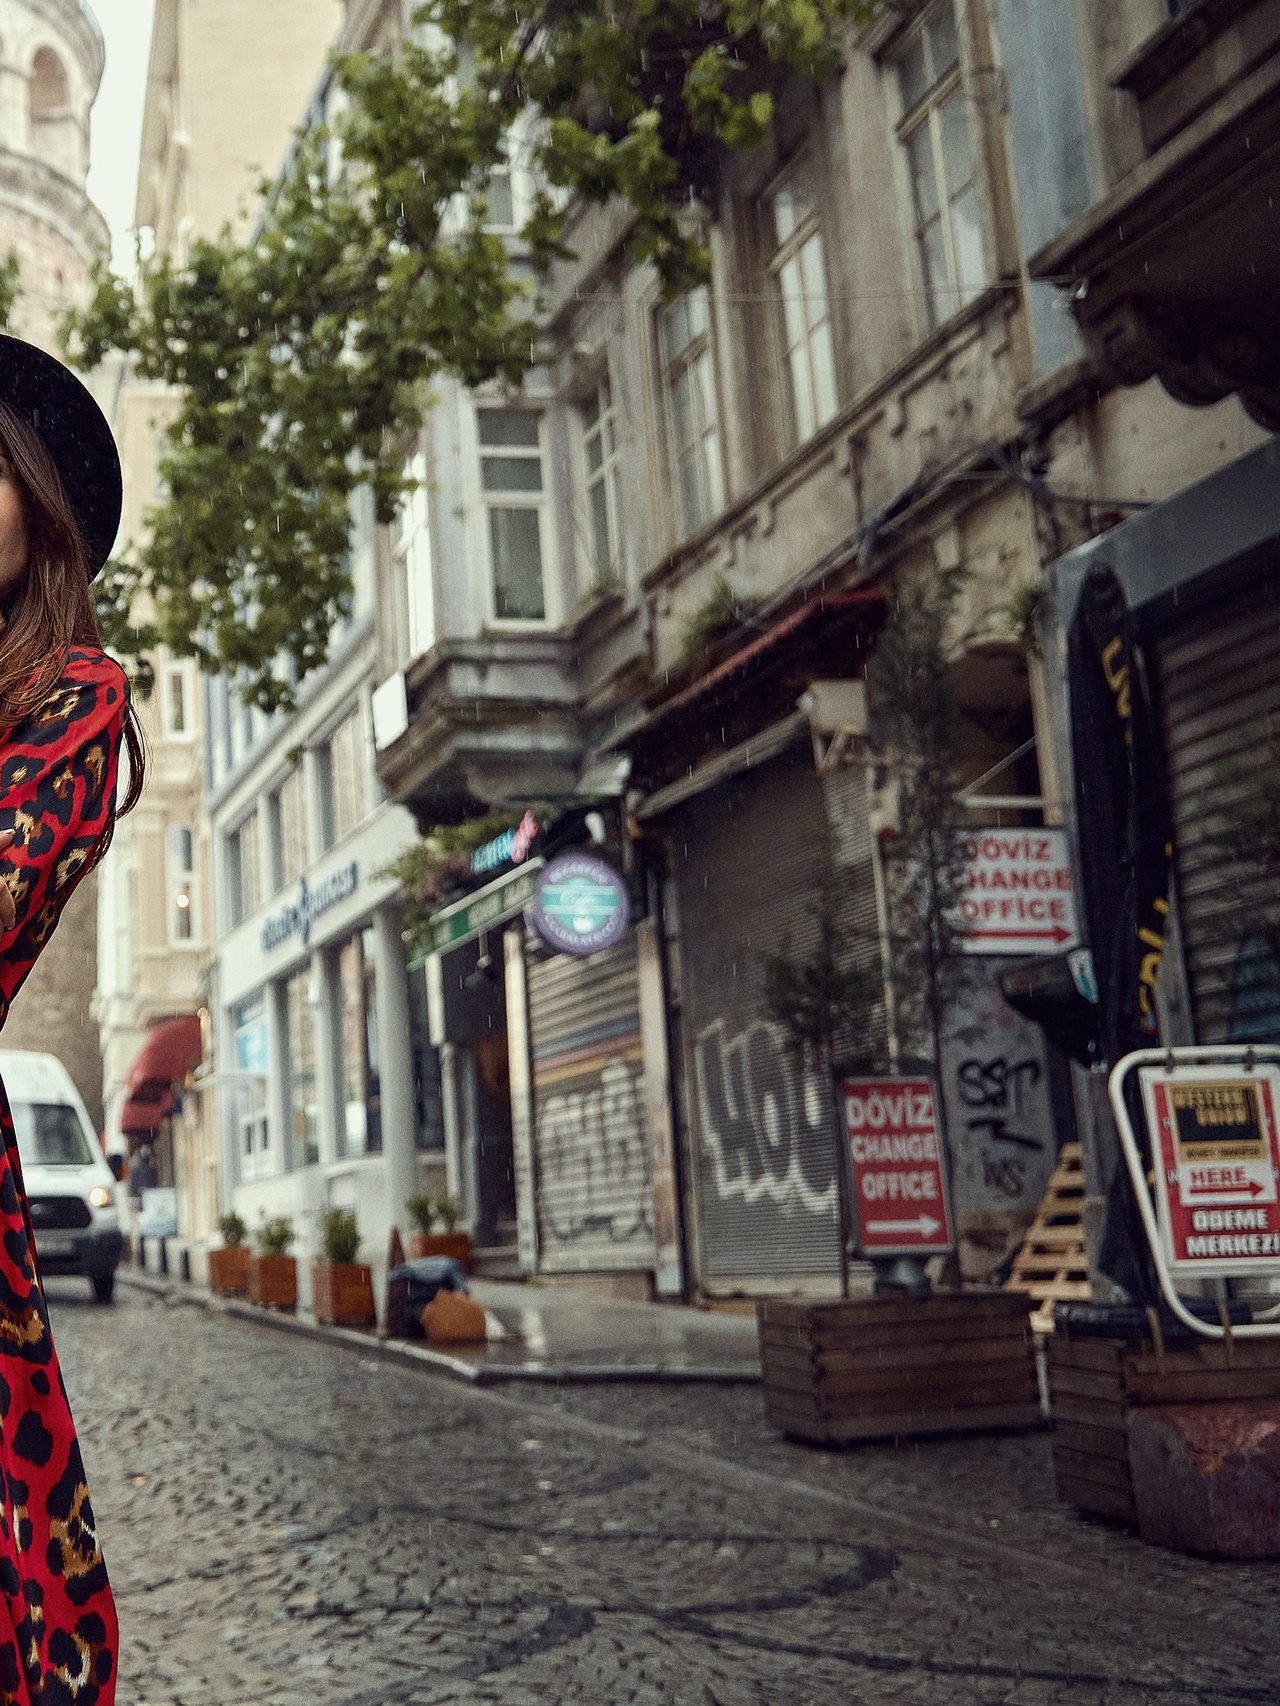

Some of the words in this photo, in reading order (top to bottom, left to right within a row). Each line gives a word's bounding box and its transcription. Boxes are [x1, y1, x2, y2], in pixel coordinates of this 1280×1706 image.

[846, 1087, 934, 1128] DÖVİZ
[851, 1133, 937, 1163] CHANGE
[862, 1171, 937, 1201] OFFICE
[1190, 1166, 1246, 1184] HERE
[1192, 1206, 1268, 1232] ÖDEME
